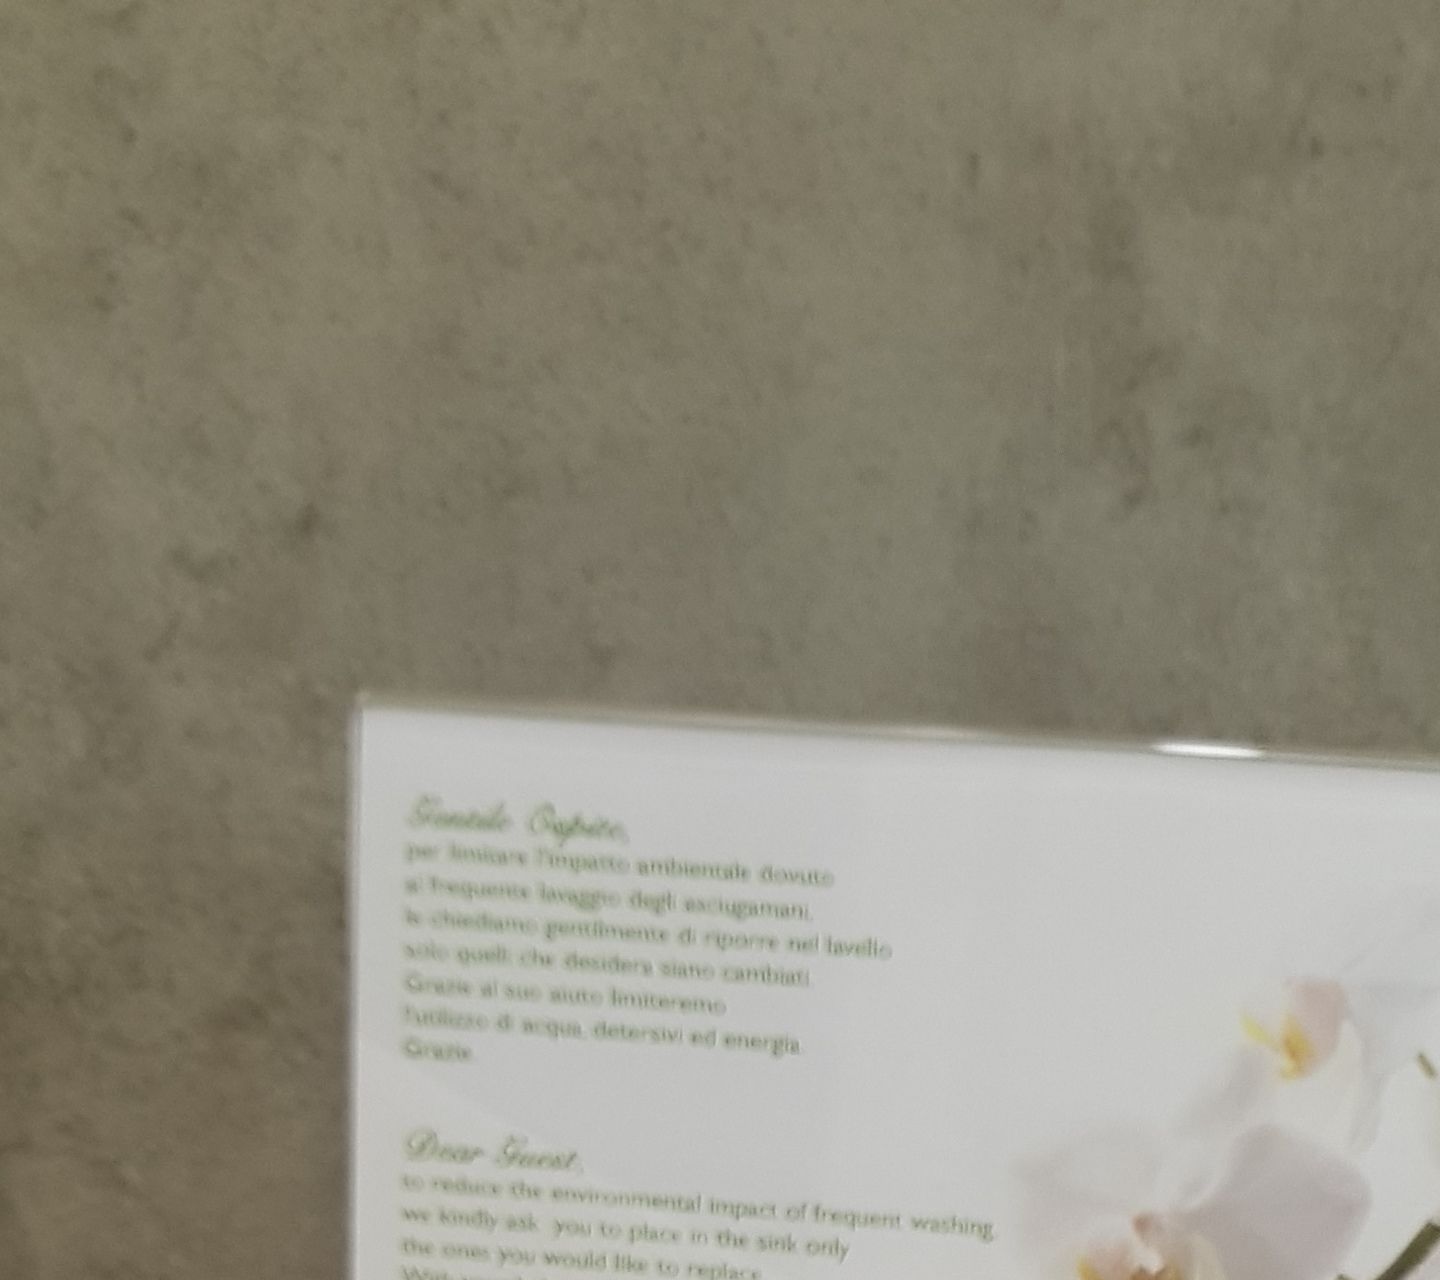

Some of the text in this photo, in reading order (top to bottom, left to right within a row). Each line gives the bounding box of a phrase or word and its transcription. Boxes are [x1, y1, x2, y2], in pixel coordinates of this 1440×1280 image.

[708, 1197, 776, 1221] impact
[784, 1202, 812, 1223] of
[813, 1203, 901, 1231] frequent
[552, 1219, 591, 1238] you
[598, 1221, 623, 1239] to
[628, 1222, 681, 1245] place
[689, 1229, 708, 1244] in
[716, 1228, 750, 1251] the
[758, 1233, 797, 1254] sink
[804, 1237, 849, 1264] only
[497, 1246, 536, 1268] you
[542, 1250, 607, 1272] would
[613, 1252, 649, 1275] like
[656, 1259, 679, 1278] to
